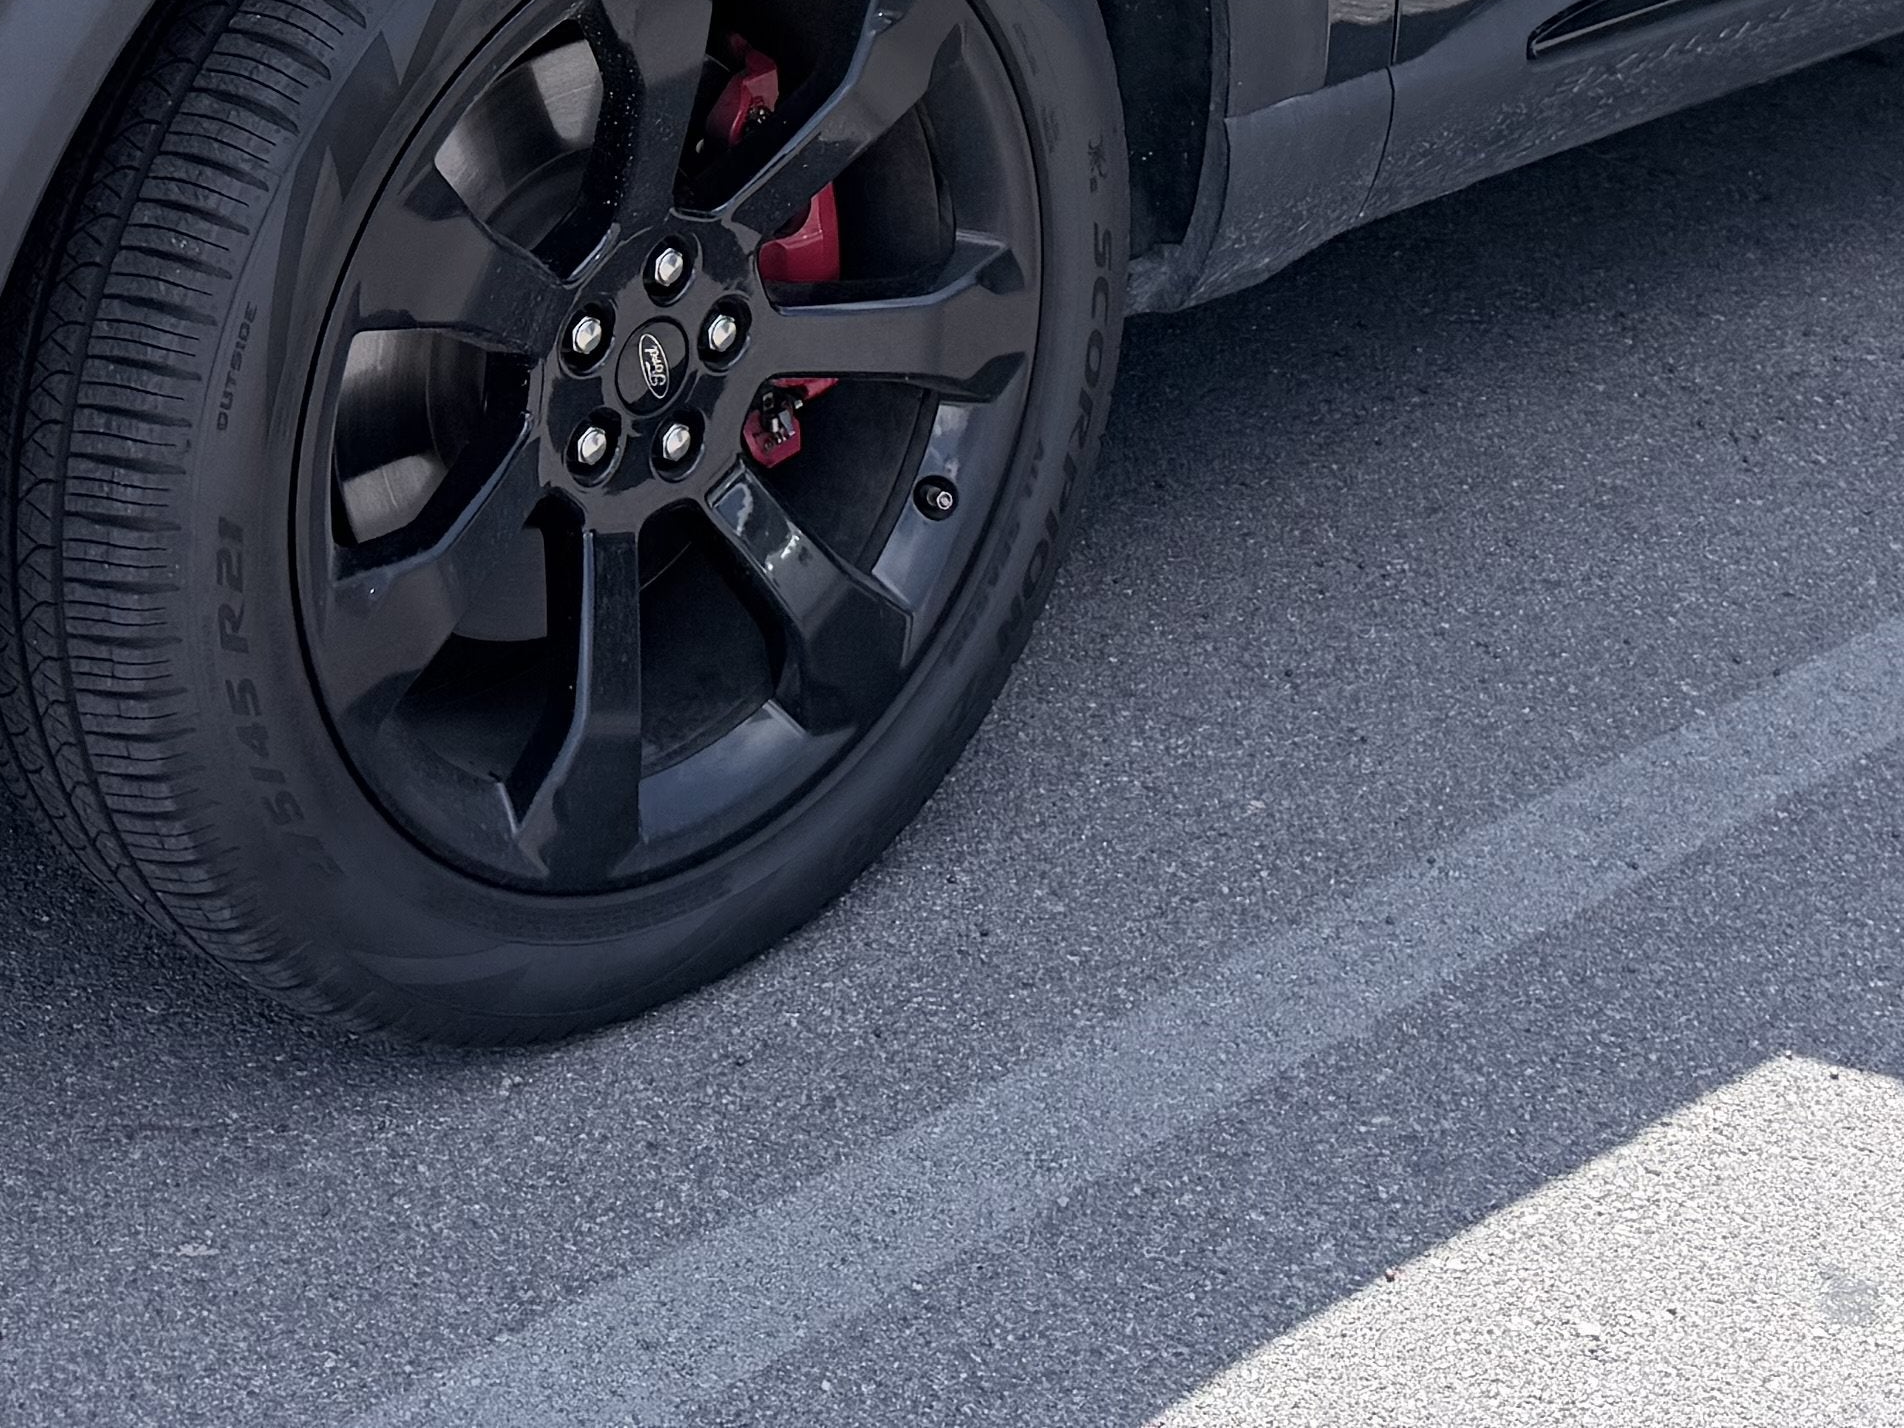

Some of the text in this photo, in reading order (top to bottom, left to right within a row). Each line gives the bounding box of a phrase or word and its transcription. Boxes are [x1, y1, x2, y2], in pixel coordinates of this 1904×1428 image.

[216, 300, 258, 432] OUTSIDE
[643, 344, 667, 387] Ford
[998, 221, 1113, 657] SCORPION
[215, 514, 250, 655] R21
